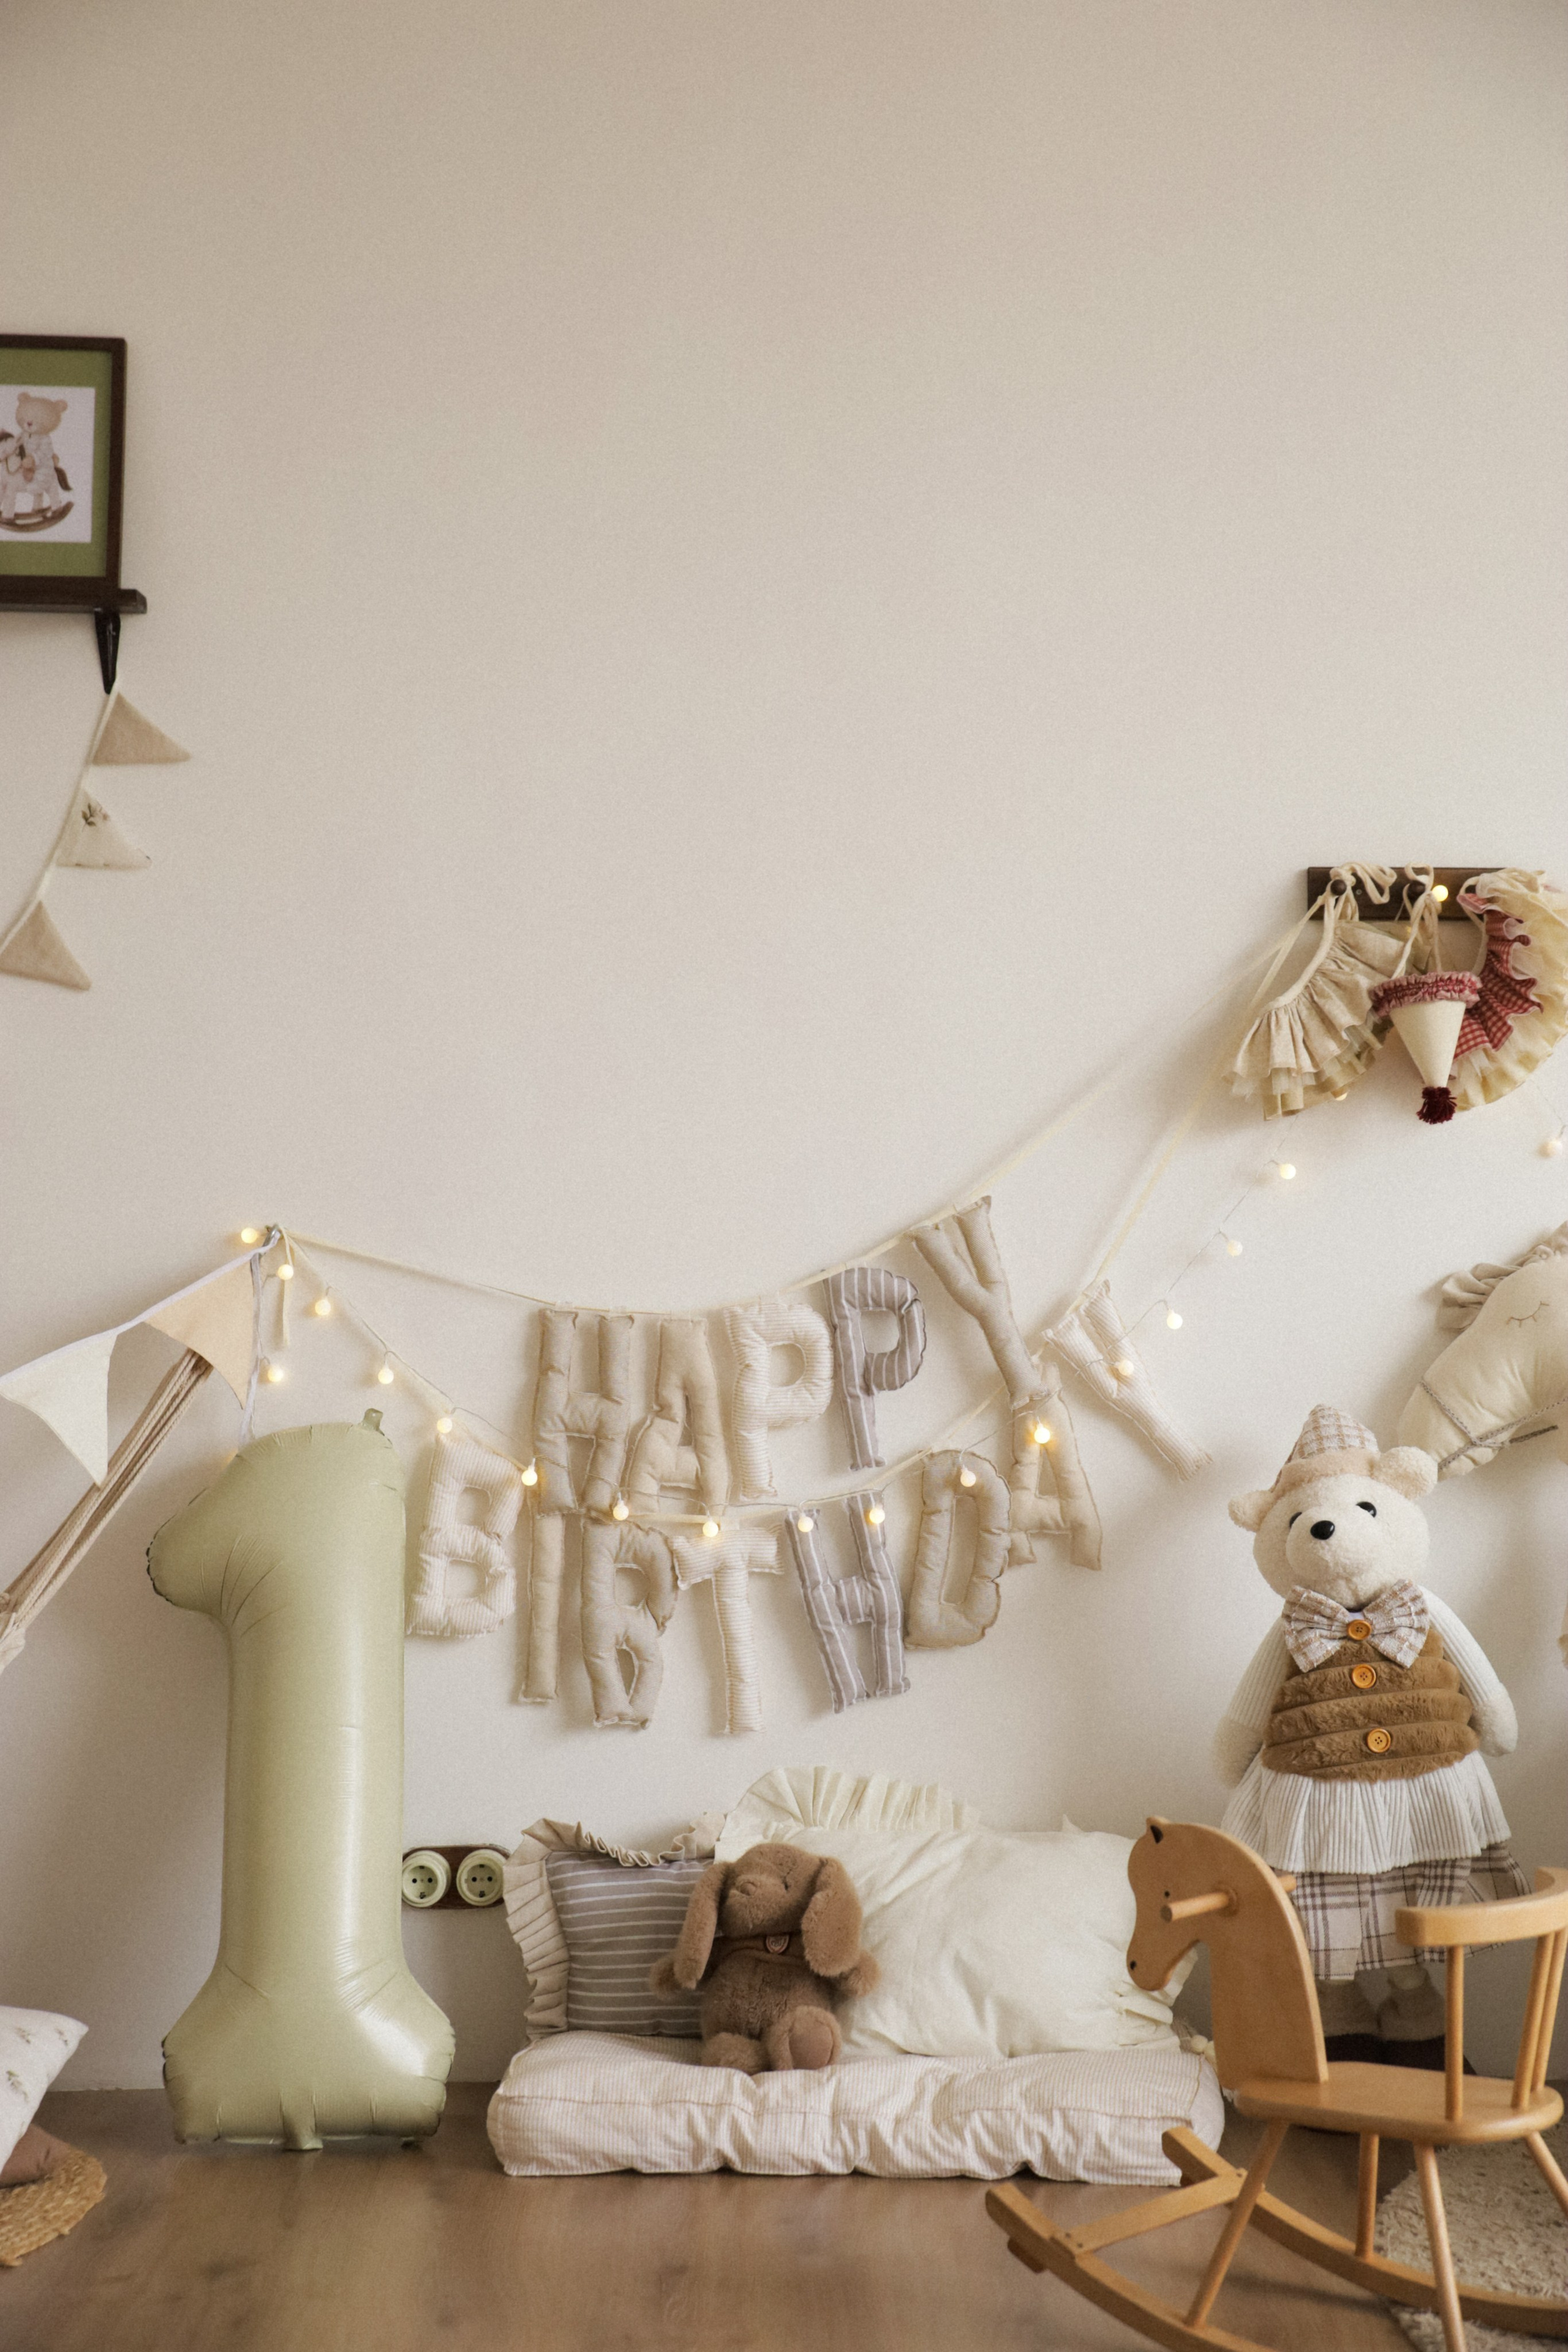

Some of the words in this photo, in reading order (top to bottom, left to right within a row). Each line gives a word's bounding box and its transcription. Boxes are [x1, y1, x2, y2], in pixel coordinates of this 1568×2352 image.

[405, 1279, 1213, 1735] BIRTHDAY
[532, 1195, 1051, 1519] HAPPY
[146, 1411, 456, 2150] 1
